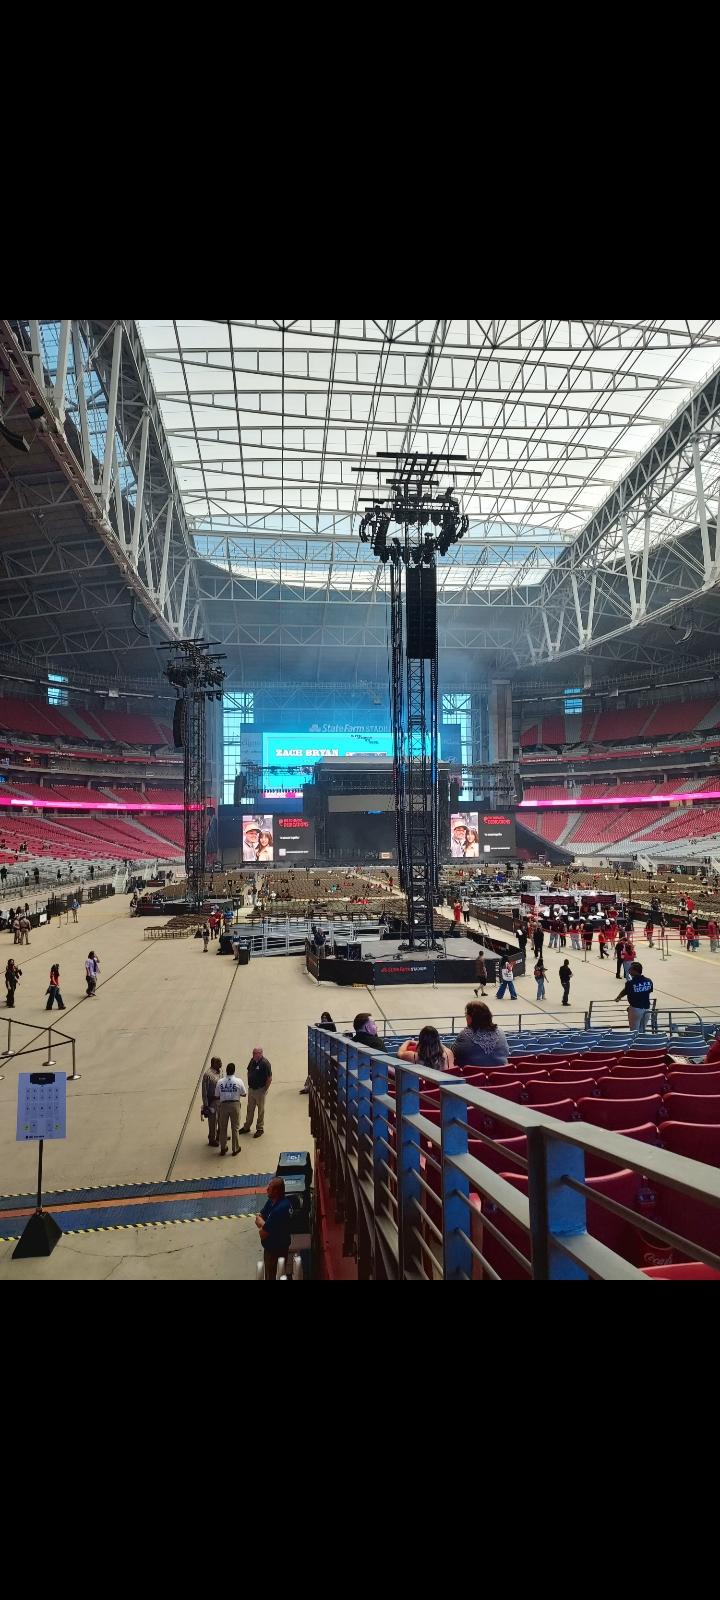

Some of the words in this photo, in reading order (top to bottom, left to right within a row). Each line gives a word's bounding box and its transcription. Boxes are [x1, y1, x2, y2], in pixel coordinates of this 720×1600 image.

[321, 723, 343, 733] State
[343, 723, 364, 733] Farm
[275, 749, 303, 757] ZACH
[305, 749, 339, 757] BRYAN
